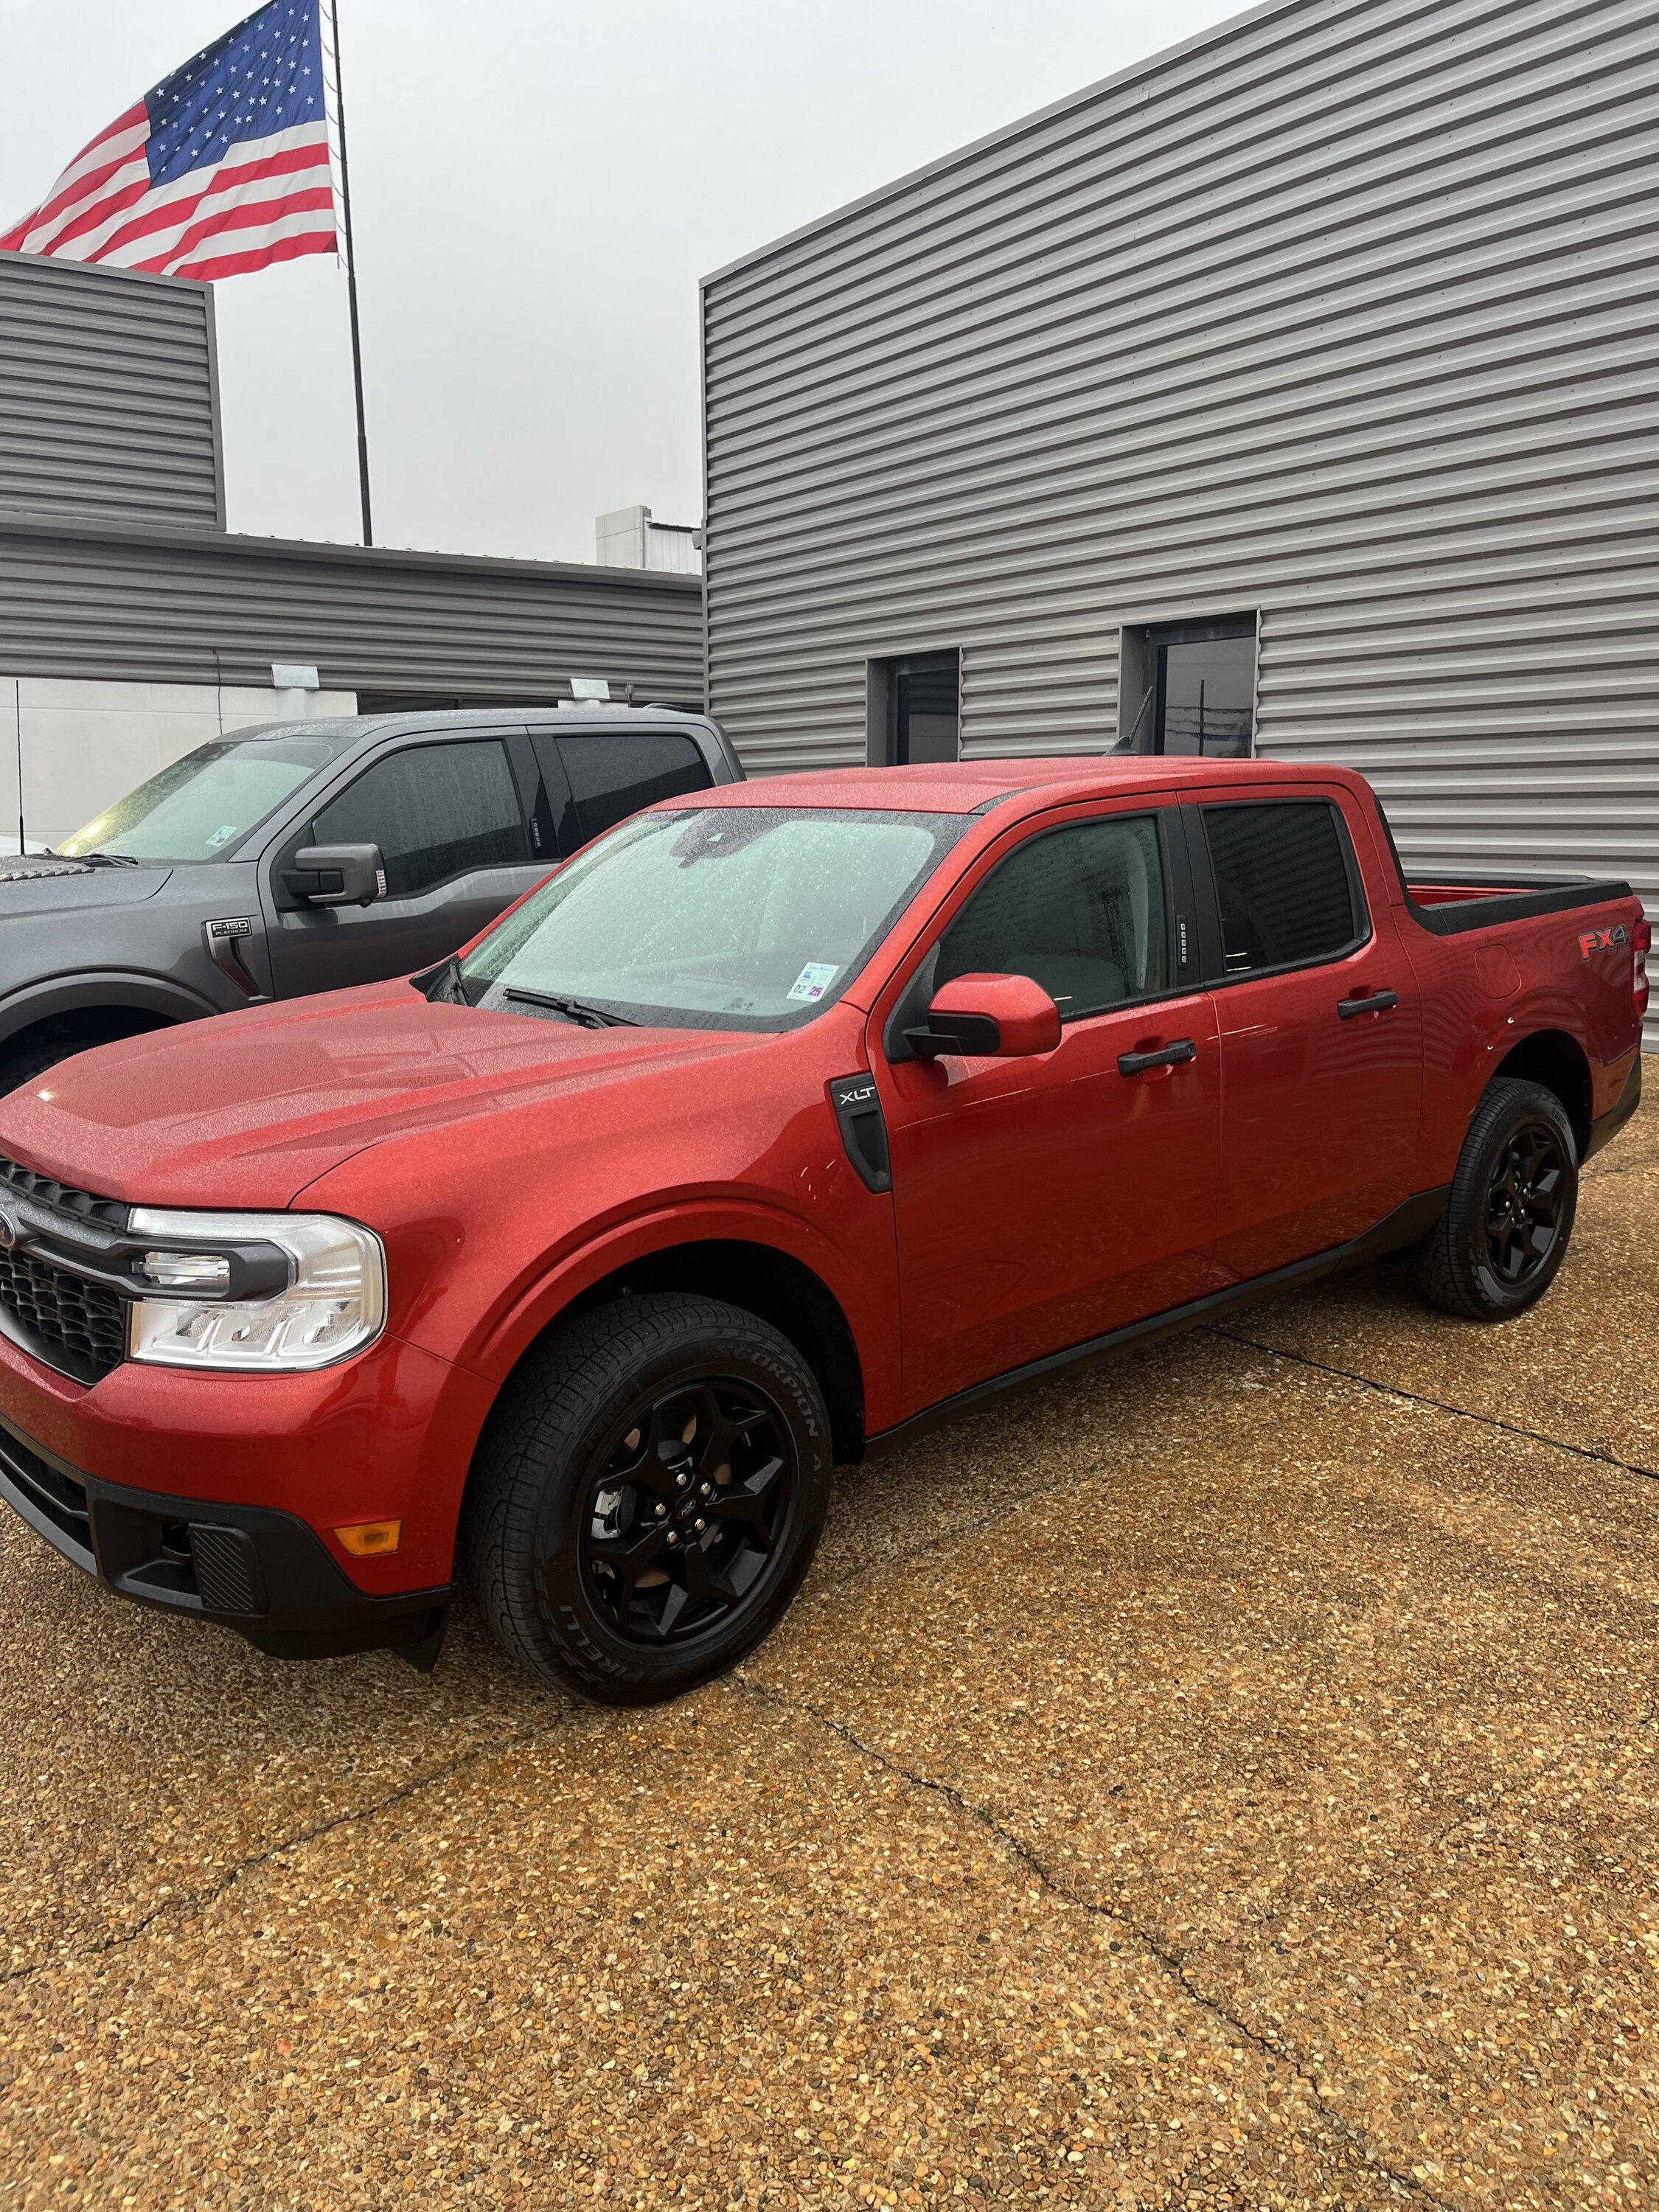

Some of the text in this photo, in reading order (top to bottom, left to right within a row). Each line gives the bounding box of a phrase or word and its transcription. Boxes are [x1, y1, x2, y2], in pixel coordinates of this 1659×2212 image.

[212, 921, 248, 931] F-150
[1578, 924, 1630, 961] FX4
[793, 984, 824, 996] 02 25
[839, 1086, 875, 1105] XLT
[717, 1343, 818, 1437] SCORPION
[558, 1605, 645, 1683] PIRELLI
